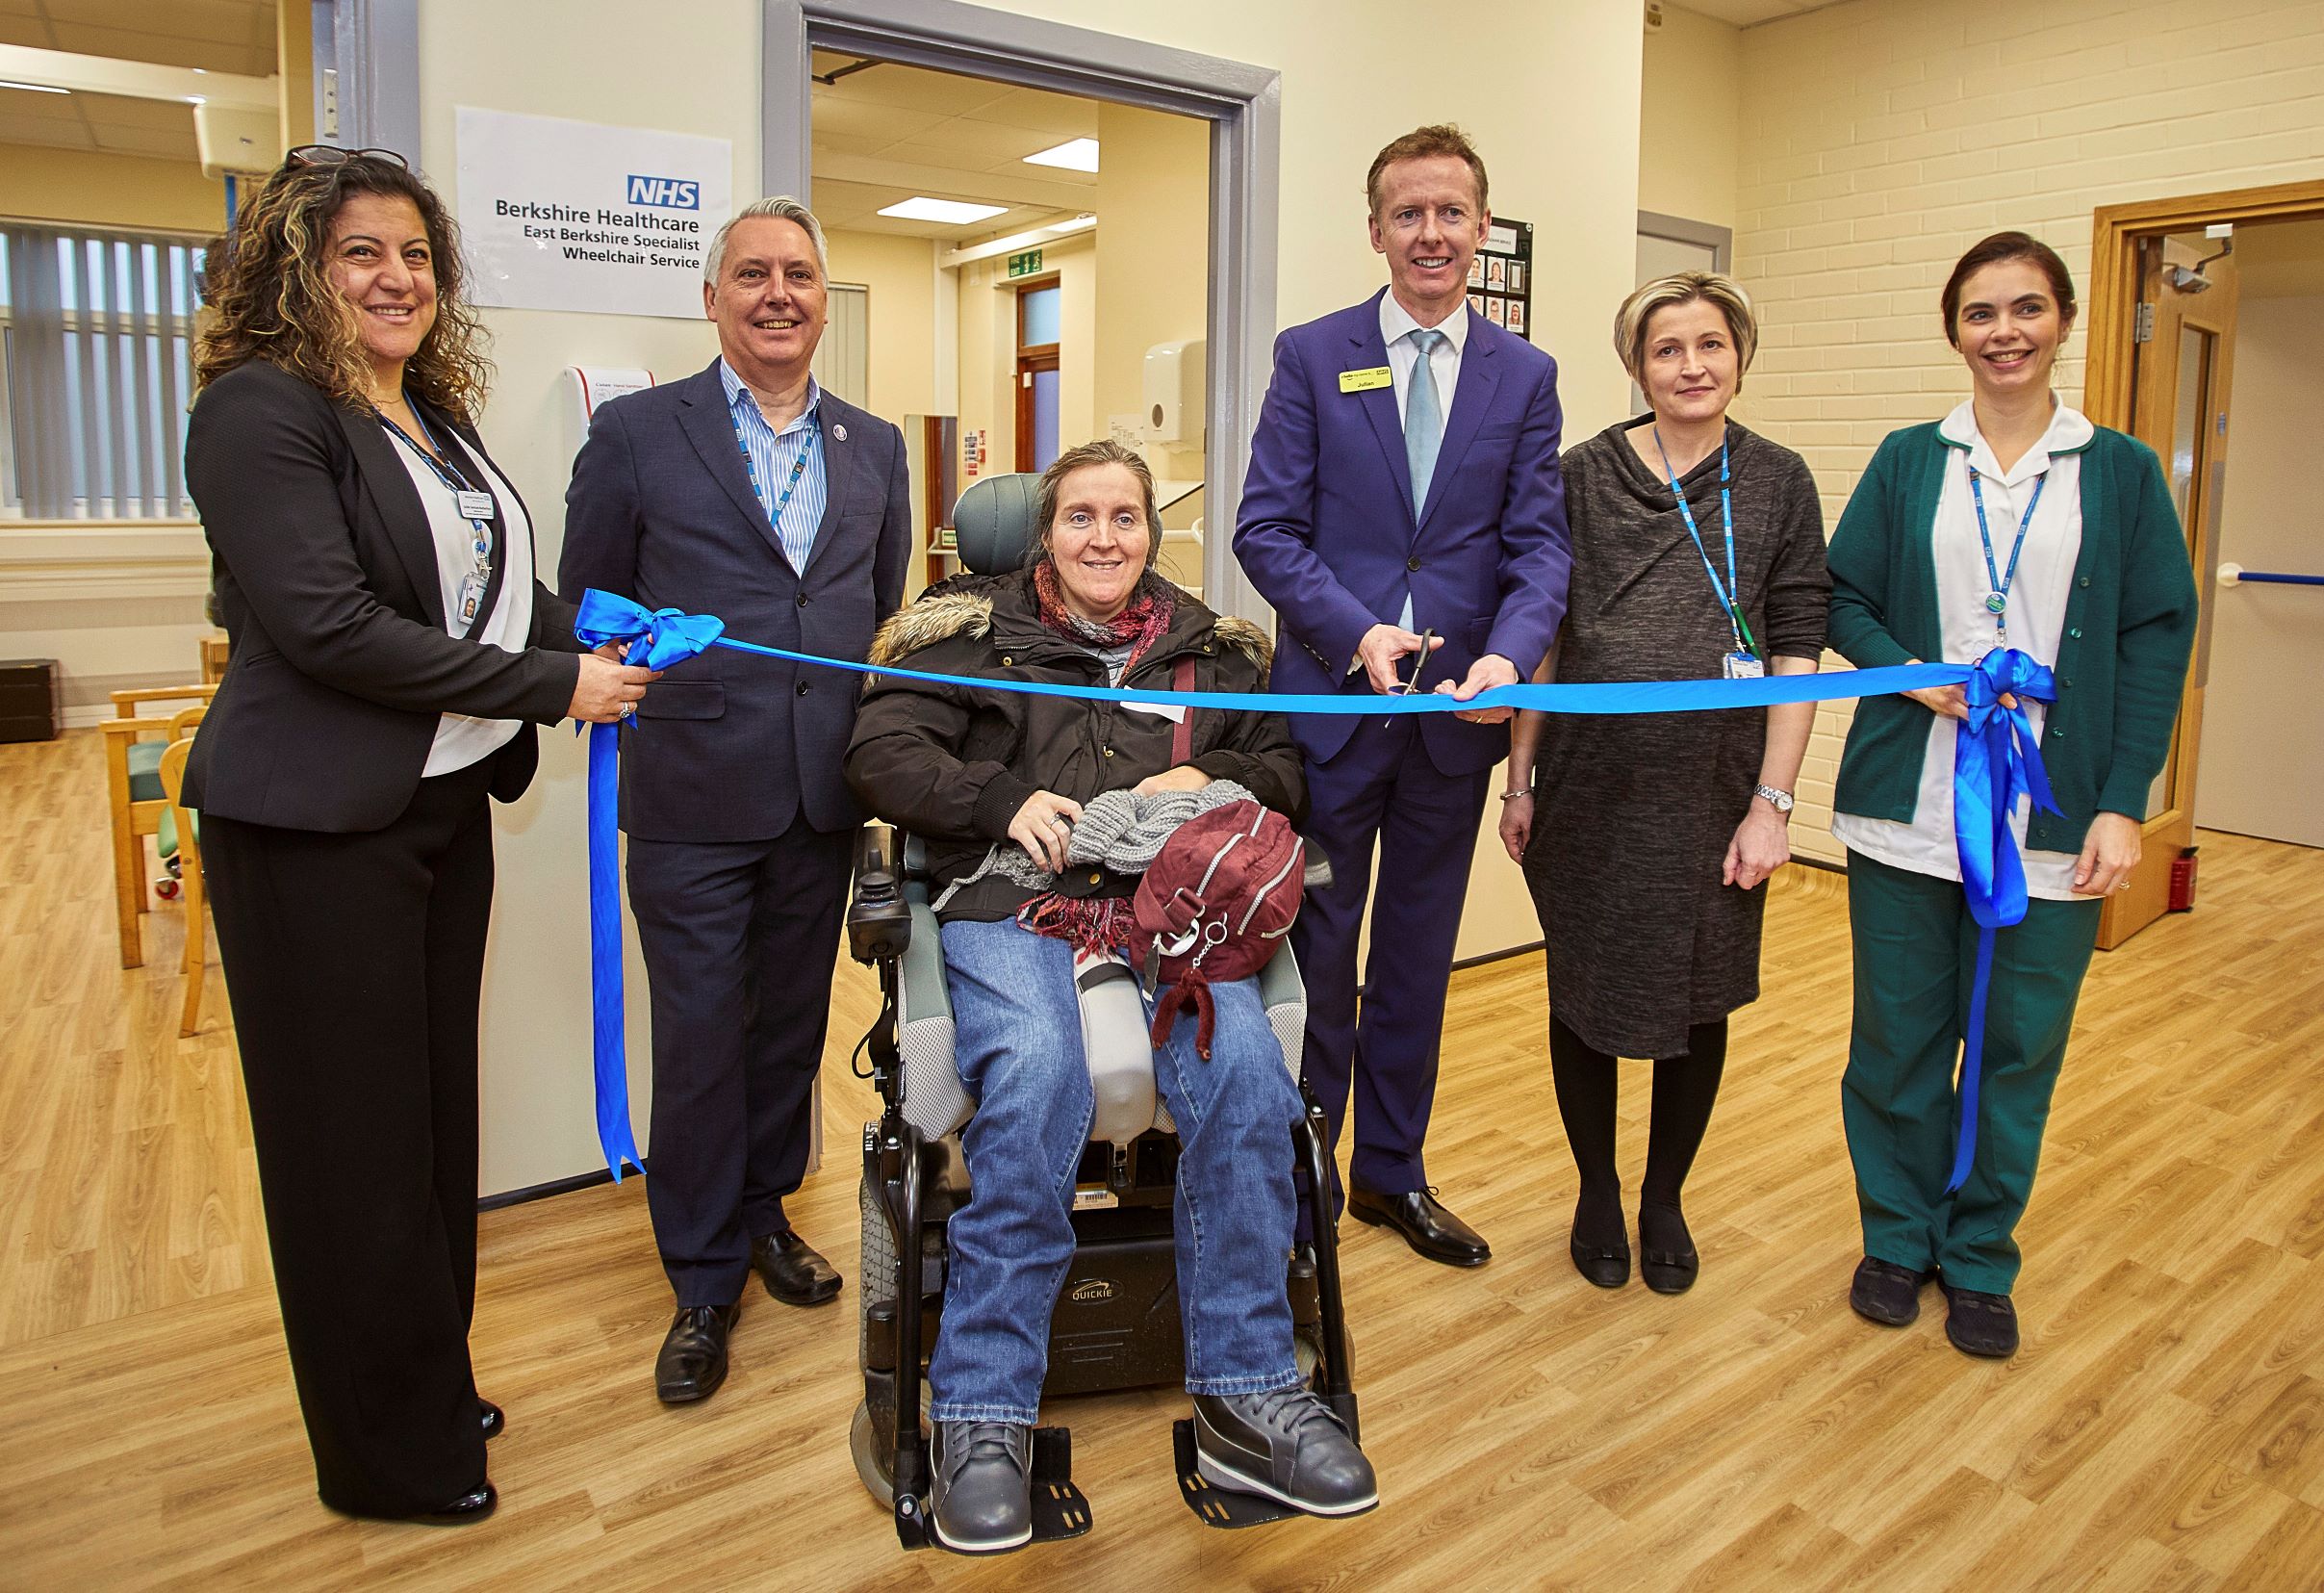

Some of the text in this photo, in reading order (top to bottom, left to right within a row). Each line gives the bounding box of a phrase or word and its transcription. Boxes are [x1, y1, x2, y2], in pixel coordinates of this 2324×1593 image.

[629, 178, 697, 208] NHS
[496, 199, 700, 233] Berkshire Healthcare
[524, 225, 700, 251] East Berkshire Specialist
[563, 246, 700, 269] Wheelchair Service
[1072, 1289, 1112, 1301] QUICKIE
